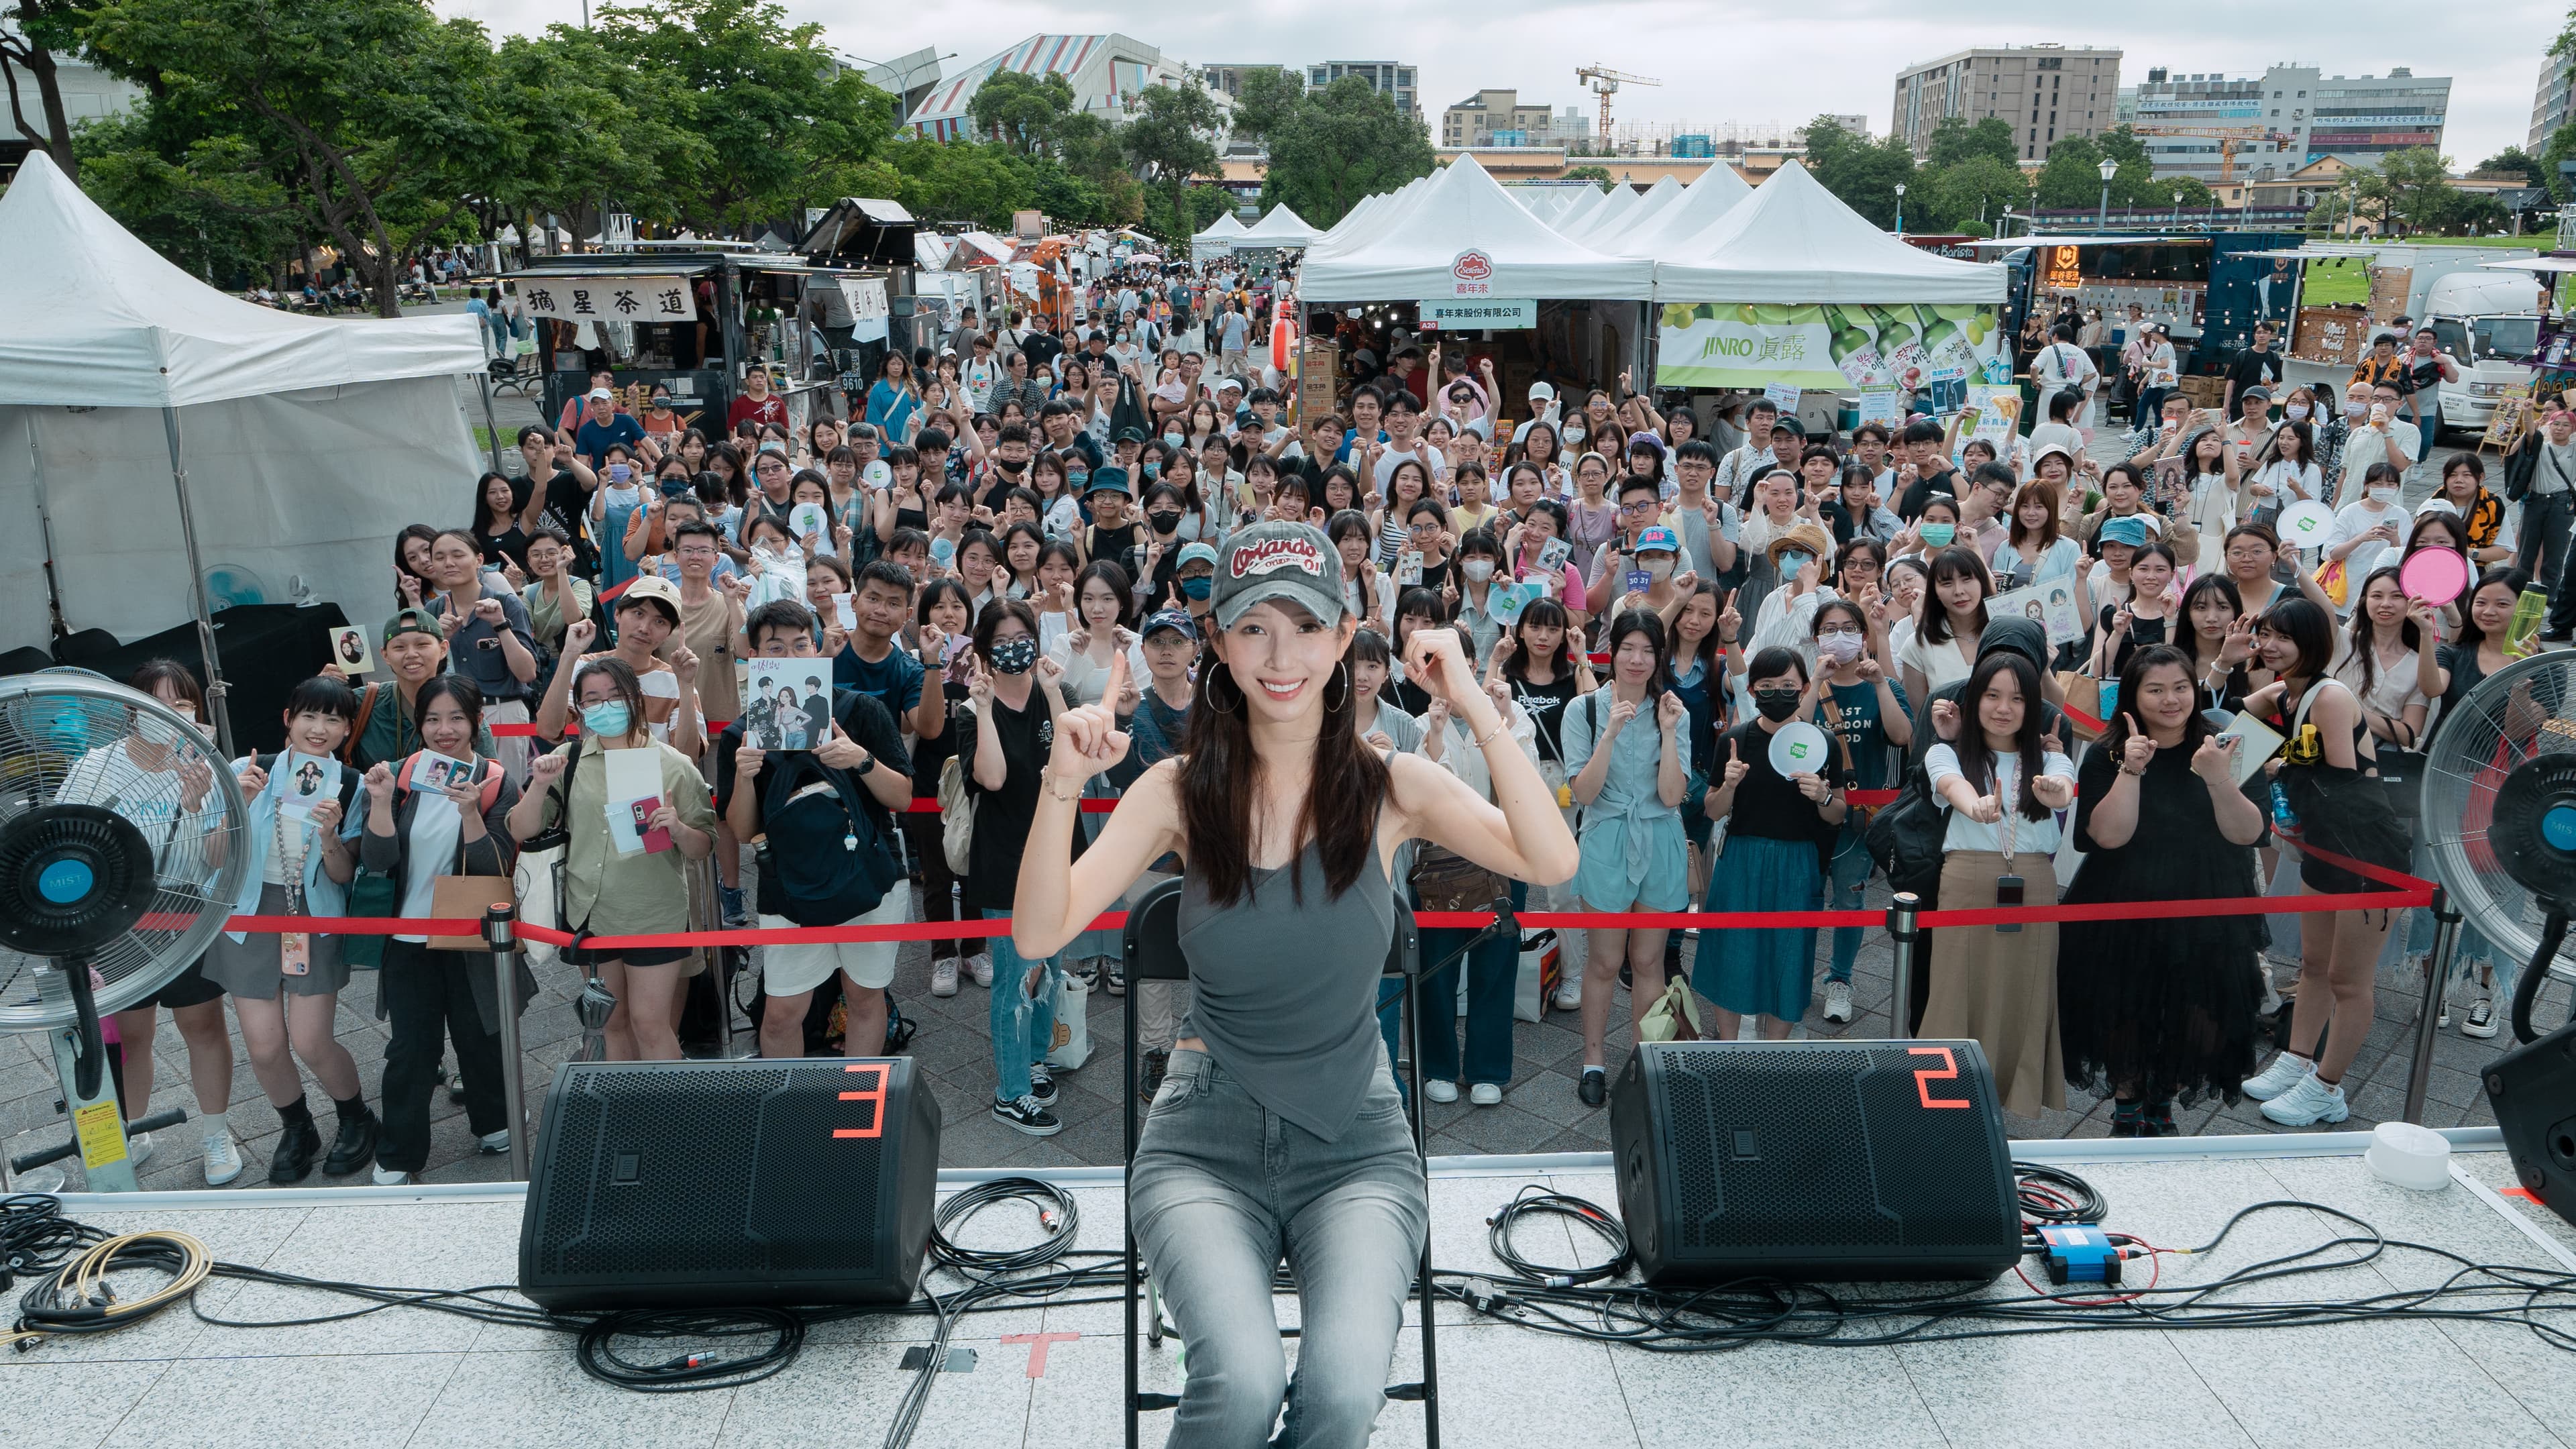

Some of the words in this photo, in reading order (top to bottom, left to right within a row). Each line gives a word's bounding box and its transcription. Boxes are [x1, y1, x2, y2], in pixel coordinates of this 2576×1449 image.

[1941, 244, 1974, 258] Barista
[1460, 266, 1485, 274] Serena
[1456, 283, 1488, 293] 喜年來
[527, 288, 686, 315] 摘星茶道
[1435, 308, 1521, 319] 喜年來股份有限公司
[2324, 321, 2347, 337] Oppa's
[1701, 337, 1754, 360] JINRO
[2322, 338, 2344, 351] World
[1912, 348, 1931, 364] 이슬
[1872, 356, 1886, 370] 이슬
[843, 378, 863, 390] 9610
[1646, 531, 1666, 542] GAP
[1232, 537, 1317, 577] Orlando
[1629, 577, 1638, 585] 30
[1640, 577, 1649, 585] 31
[1839, 707, 1862, 716] AST
[1815, 720, 1872, 729] LODON
[2552, 821, 2576, 837] MIS
[49, 875, 81, 888] MIST
[1908, 1046, 1970, 1109] 2
[832, 1064, 891, 1138] 3
